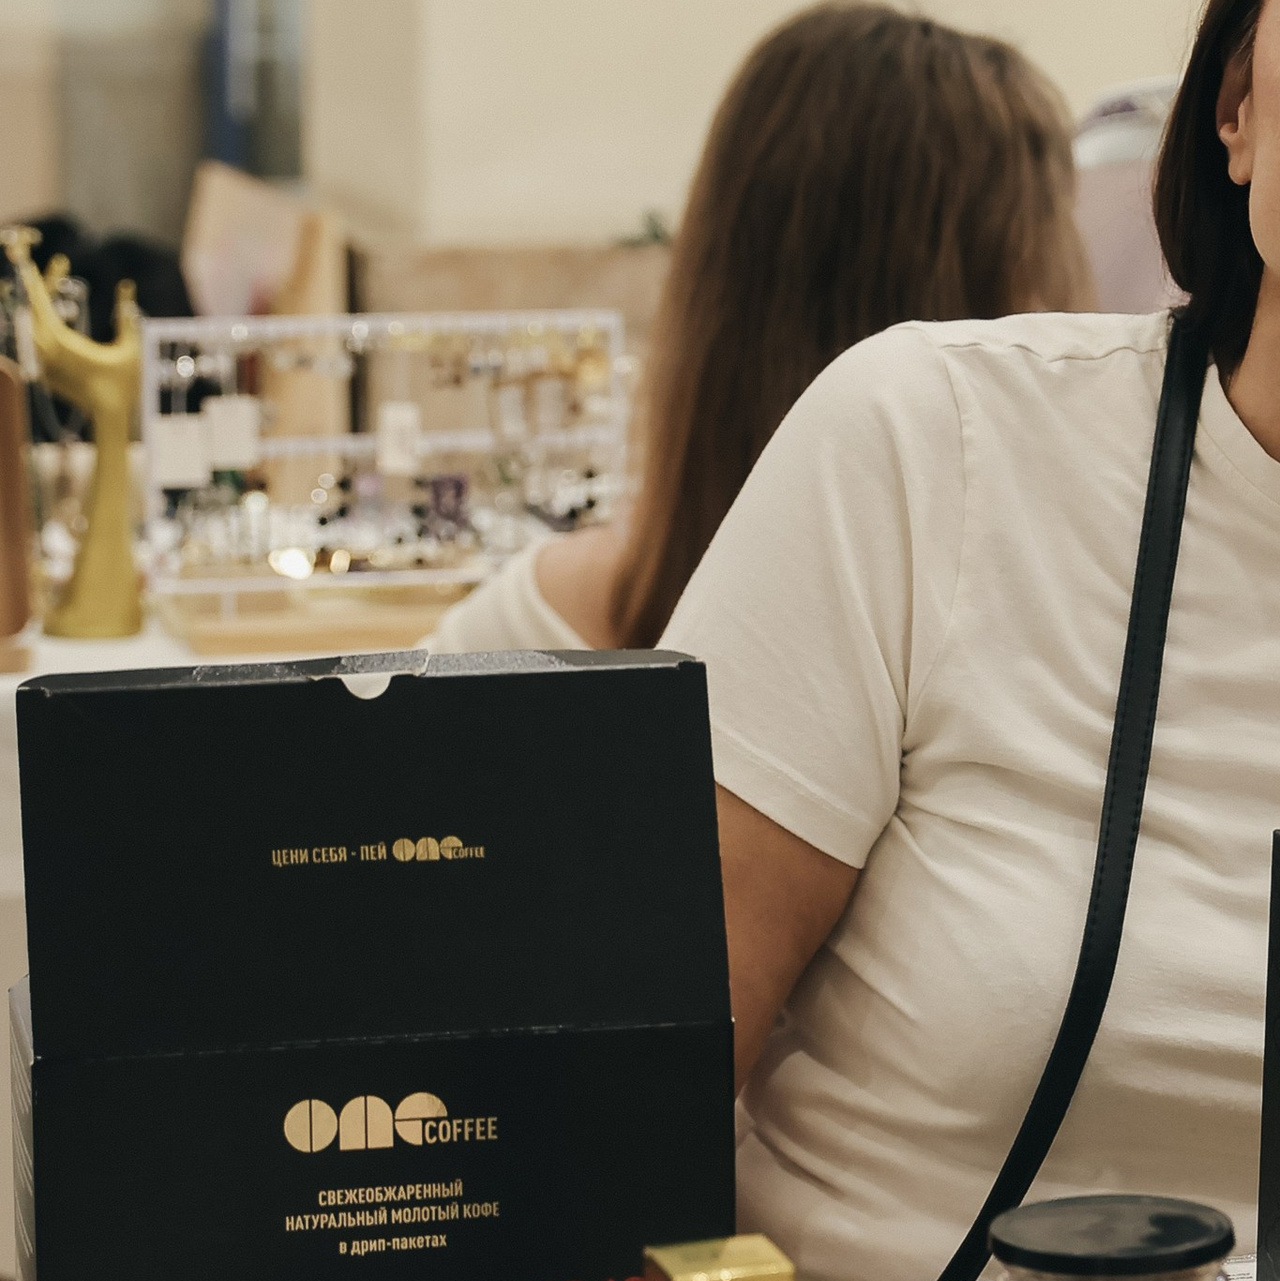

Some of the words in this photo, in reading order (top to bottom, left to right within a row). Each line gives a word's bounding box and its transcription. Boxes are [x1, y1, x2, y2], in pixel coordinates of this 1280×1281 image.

[271, 848, 309, 867] ЦЕНИ
[312, 846, 347, 864] СЕБЯ
[360, 841, 387, 861] ПЕЙ
[452, 846, 485, 860] COFFEE
[424, 1117, 499, 1145] COFFEE
[318, 1178, 464, 1207] СВЕЖЕОБЖАРЕННЫЙ
[285, 1206, 388, 1232] НАТУРАЛЬНЫЙ
[391, 1201, 460, 1226] МОЛОТЫЙ
[463, 1201, 500, 1219] КОФЕ
[338, 1241, 348, 1254] в
[350, 1234, 448, 1257] дрип-пакетах
